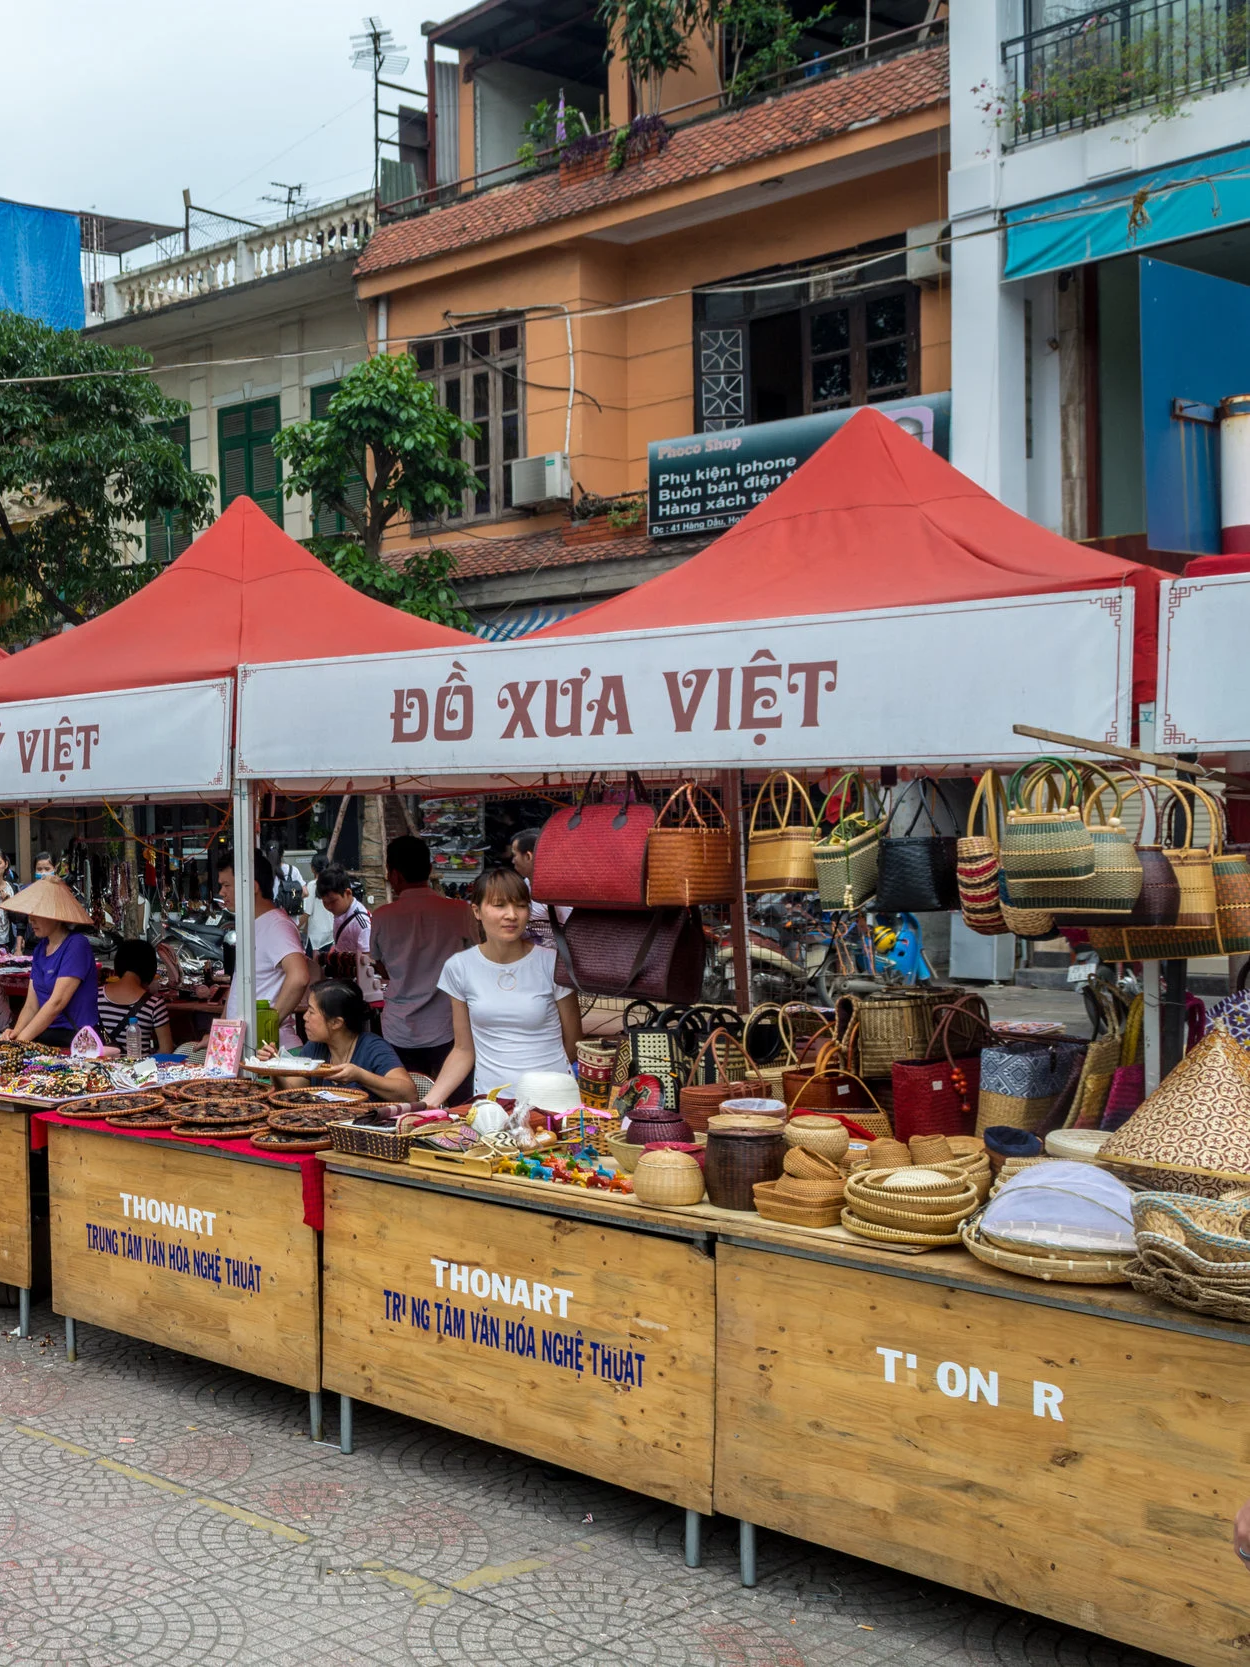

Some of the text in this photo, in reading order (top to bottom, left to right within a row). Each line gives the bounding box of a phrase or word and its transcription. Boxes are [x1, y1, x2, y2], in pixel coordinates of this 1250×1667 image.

[705, 437, 742, 452] Shop
[658, 473, 690, 486] Phụ
[696, 466, 731, 482] kiện
[736, 456, 797, 476] iphone
[658, 486, 702, 501] Buôn
[707, 479, 738, 495] bán
[743, 473, 781, 489] điện
[658, 491, 771, 517] Hàng xách ta
[670, 524, 680, 532] 41
[390, 649, 838, 746] ĐỒ XƯA VIỆT
[17, 716, 100, 782] VIỆT
[119, 1192, 217, 1236] THONART
[86, 1223, 262, 1298] TRUNG TÂM VĂN HÓA NGHỆ THUẬT
[430, 1258, 574, 1319] THONART
[434, 1298, 466, 1340] TÂM
[470, 1306, 500, 1349] VĂN
[505, 1316, 536, 1360] HÓA
[541, 1330, 585, 1379] NGHỆ
